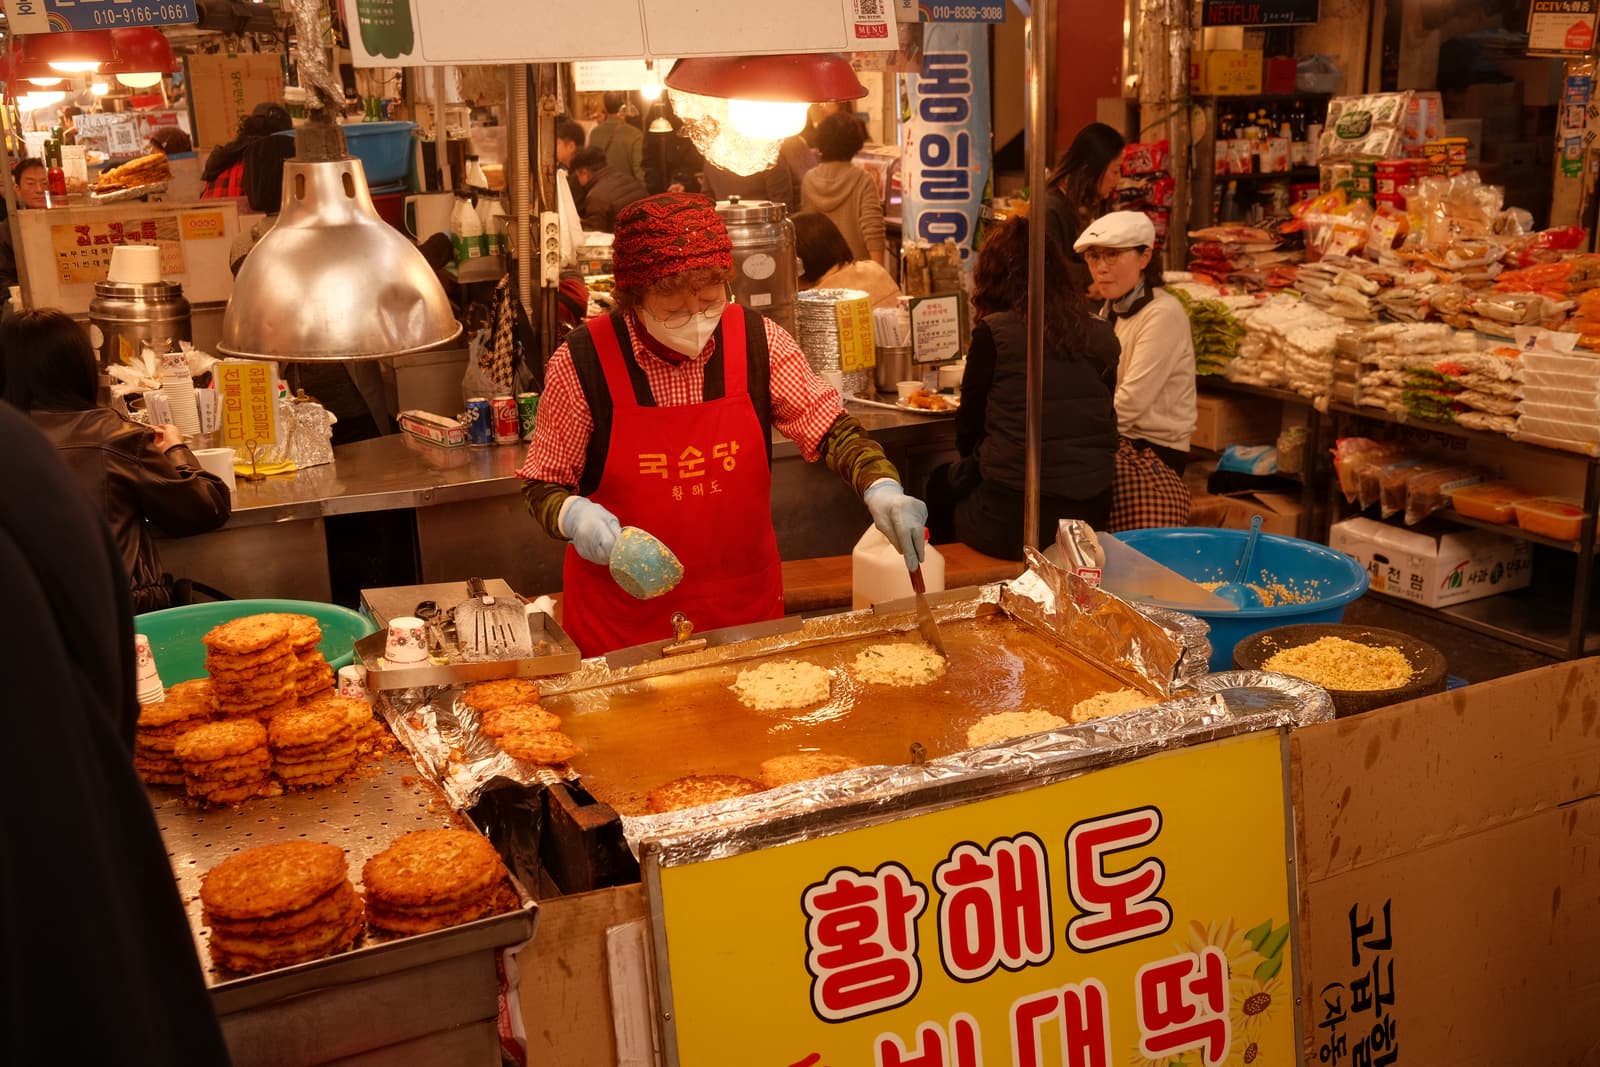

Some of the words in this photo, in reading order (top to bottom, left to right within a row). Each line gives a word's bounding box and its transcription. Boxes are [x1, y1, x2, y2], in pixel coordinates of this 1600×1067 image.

[94, 4, 189, 25] 010-9166-0661
[1207, 5, 1260, 23] NETFLIX
[1535, 2, 1561, 11] CCTV
[858, 25, 884, 34] MENU
[224, 368, 245, 440] 선불입니다
[638, 440, 740, 479] 국순당
[803, 808, 1171, 1021] 황해도
